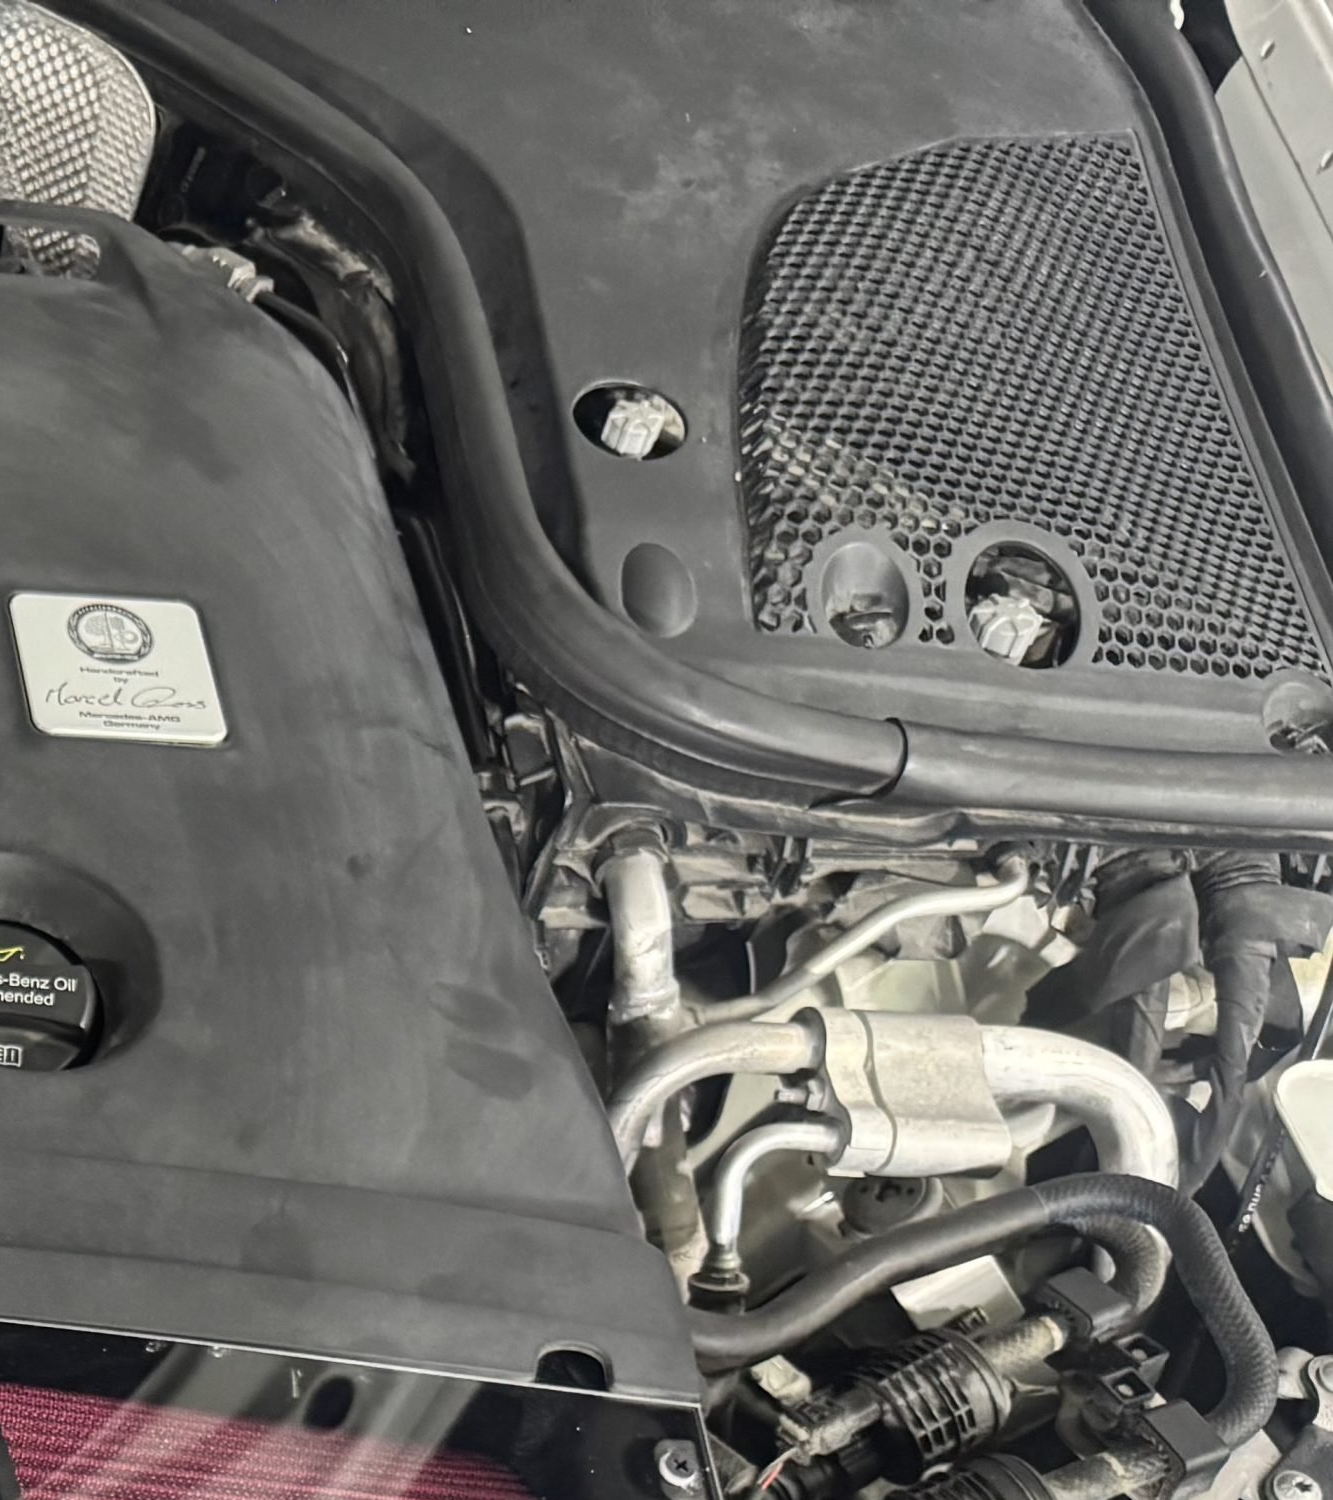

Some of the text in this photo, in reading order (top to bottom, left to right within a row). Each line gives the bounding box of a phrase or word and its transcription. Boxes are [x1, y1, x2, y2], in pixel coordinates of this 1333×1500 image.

[79, 666, 159, 678] Handcrafted
[113, 676, 129, 684] by
[78, 710, 181, 723] Mercedes-AMG
[102, 720, 161, 731] Germany
[53, 976, 78, 993] Oil
